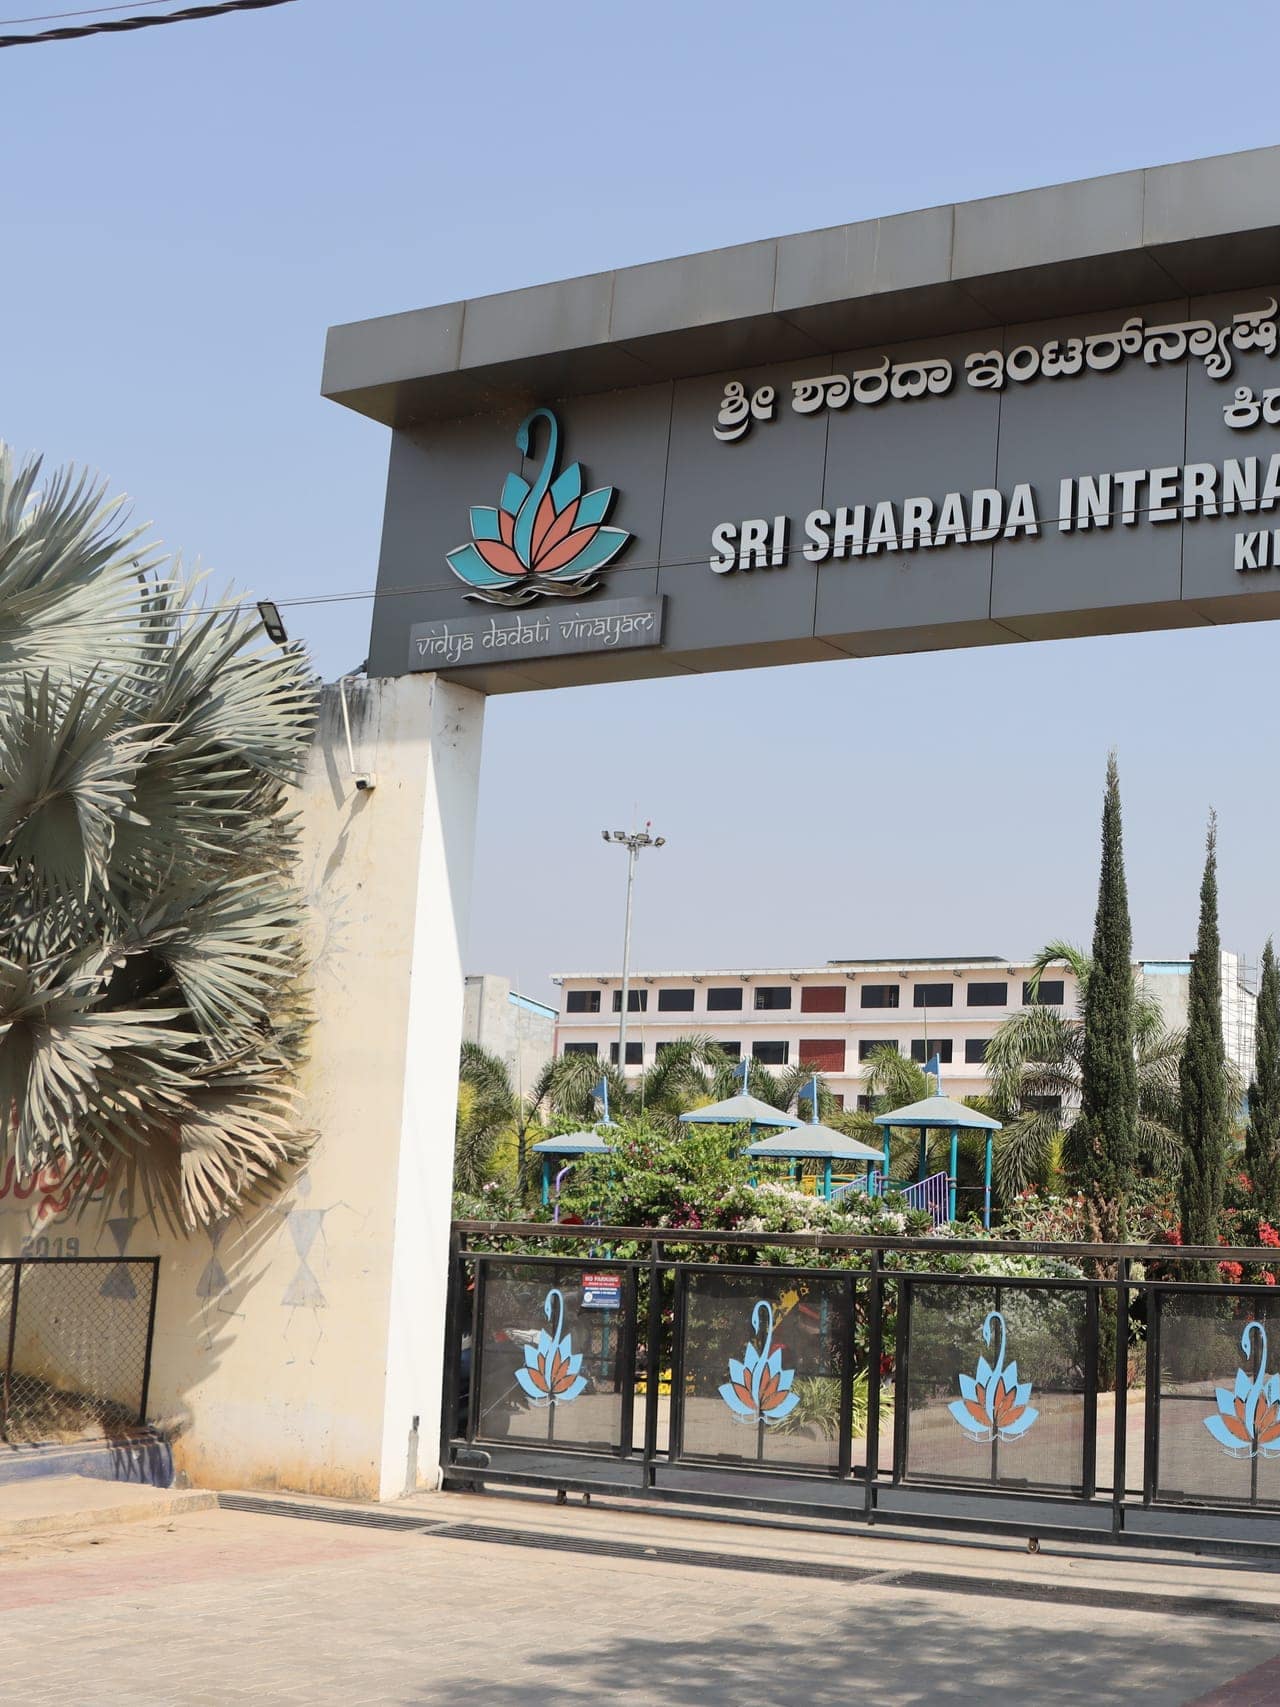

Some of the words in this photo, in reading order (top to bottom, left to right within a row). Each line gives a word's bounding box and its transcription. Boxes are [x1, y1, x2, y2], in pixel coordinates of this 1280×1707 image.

[713, 381, 775, 441] ಶ್ರೀ
[791, 355, 953, 414] ಶಾರದಾ
[709, 515, 789, 575] SRI
[803, 483, 1040, 563] SHARADA
[415, 623, 475, 663] vidya
[482, 615, 551, 649] dadati
[558, 611, 657, 646] vinayam
